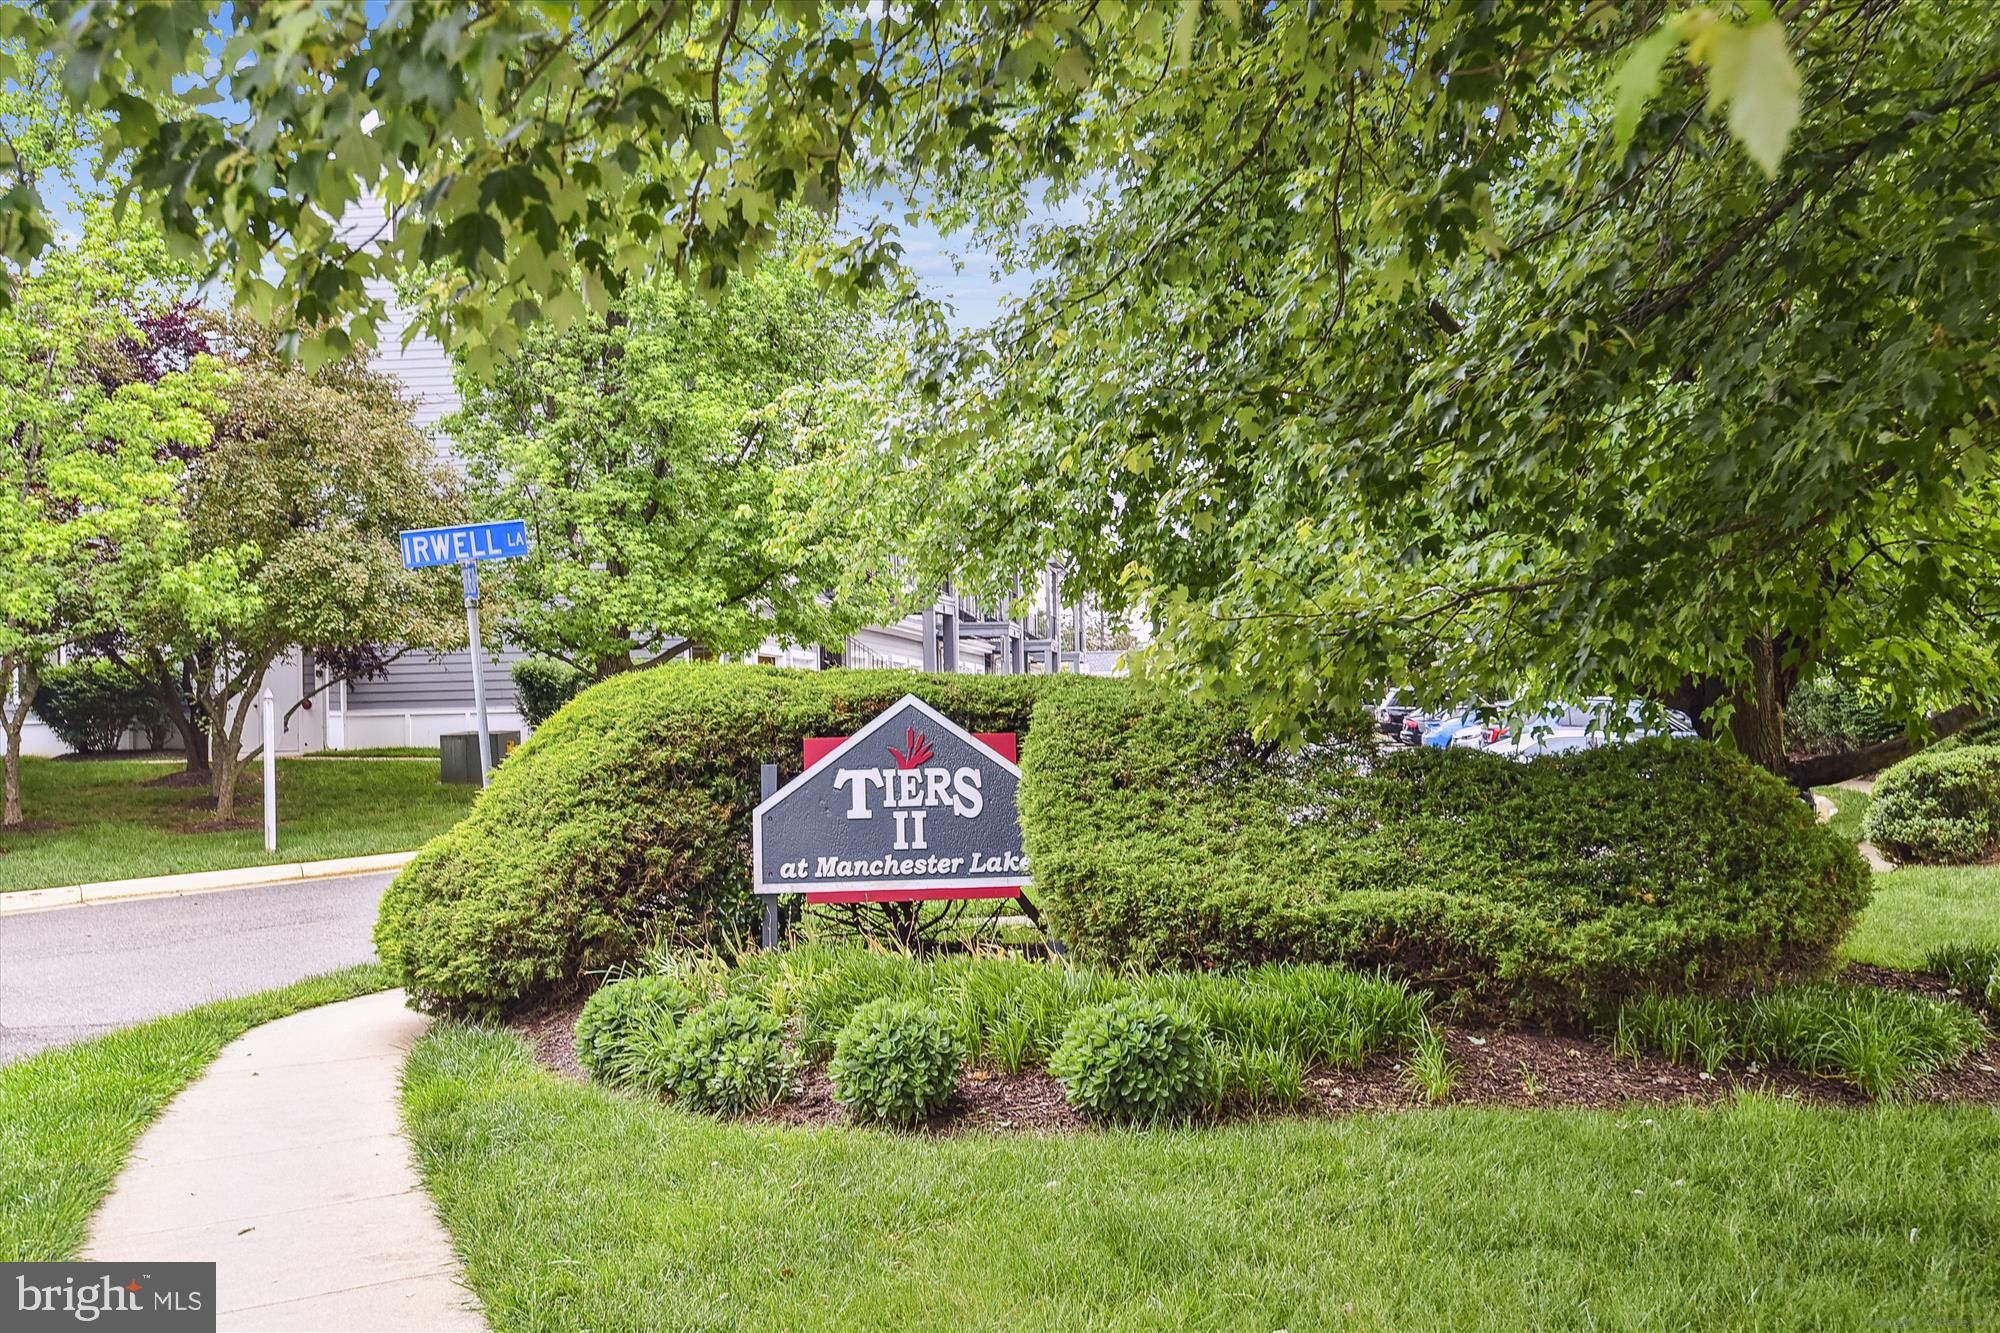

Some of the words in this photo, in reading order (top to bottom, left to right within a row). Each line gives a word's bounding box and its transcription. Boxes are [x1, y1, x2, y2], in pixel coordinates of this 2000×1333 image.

[402, 529, 502, 564] IRWELL
[507, 533, 525, 547] LA
[833, 767, 984, 819] TIERS
[893, 810, 928, 850] II
[779, 859, 809, 879] at
[814, 854, 965, 877] Manchester
